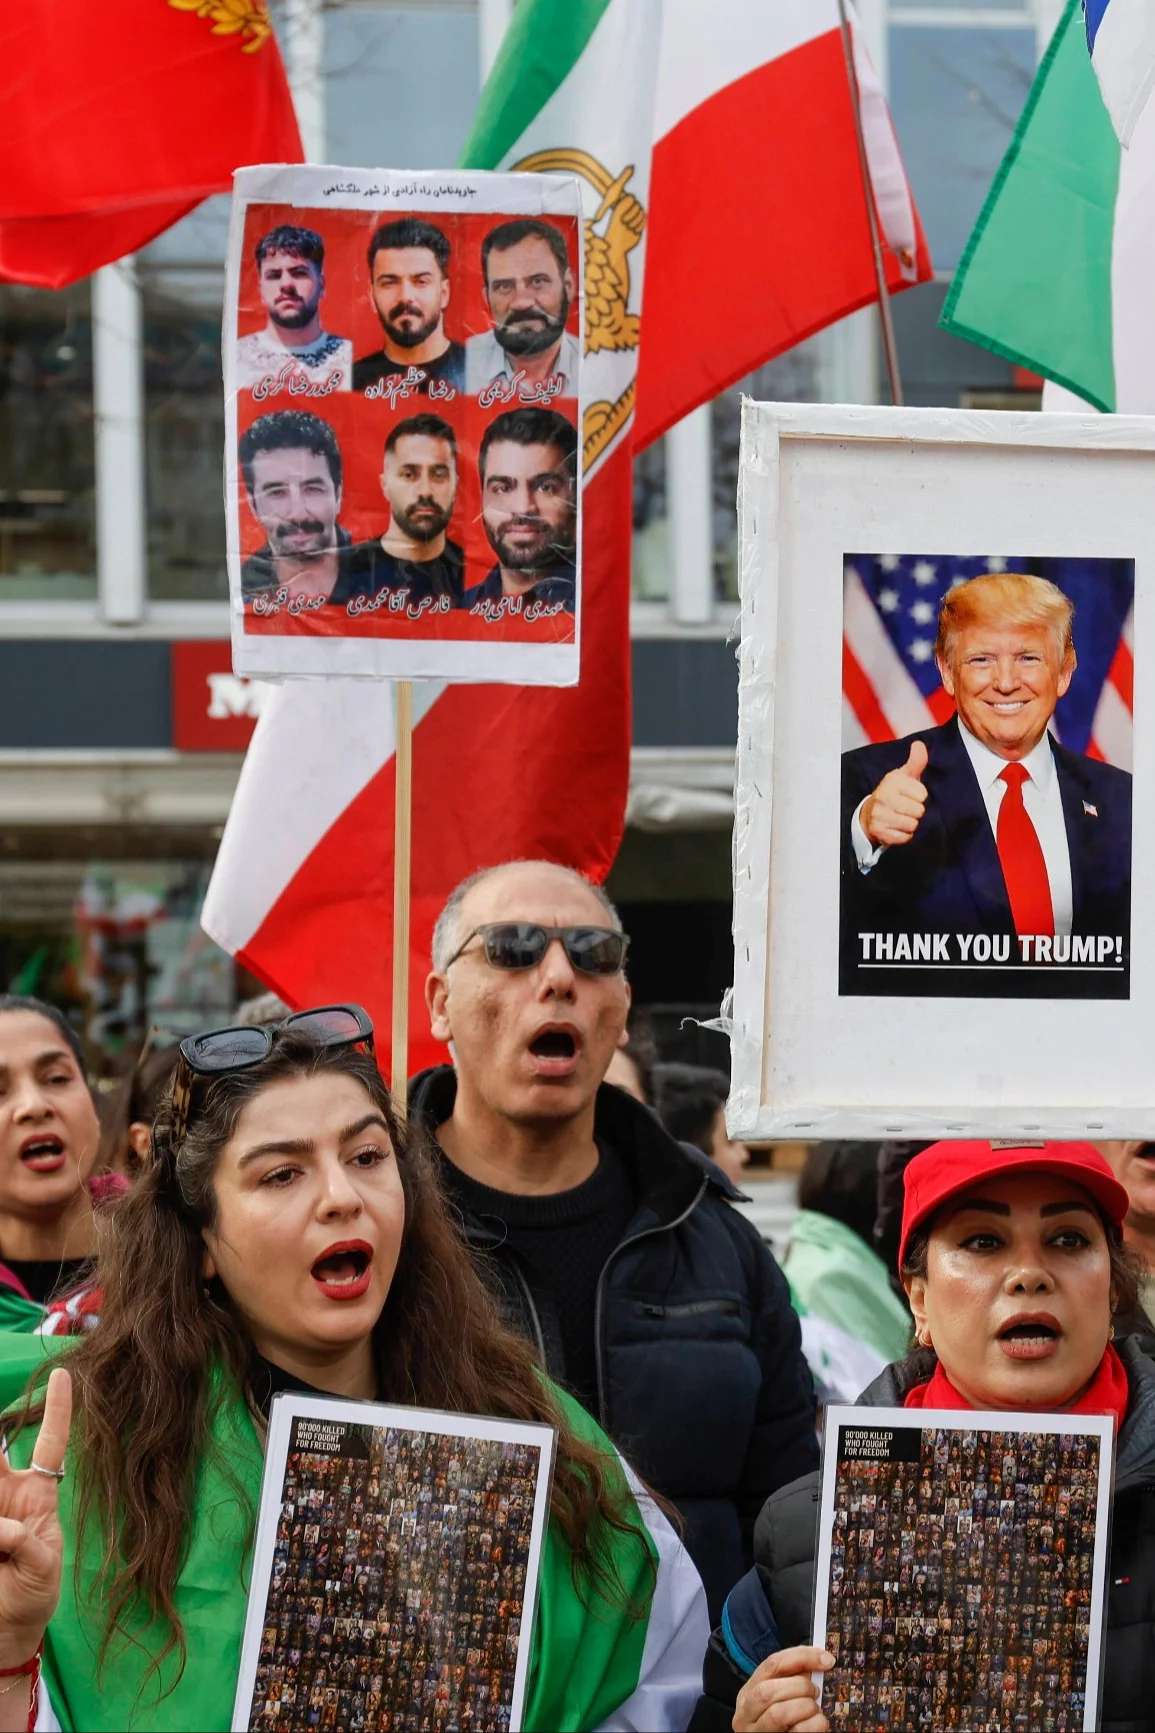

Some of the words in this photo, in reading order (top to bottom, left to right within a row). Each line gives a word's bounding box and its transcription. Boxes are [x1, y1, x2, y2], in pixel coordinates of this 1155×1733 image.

[392, 182, 416, 197] آزادی
[429, 380, 456, 401] رضا
[479, 370, 526, 408] کریمی
[519, 376, 563, 404] لطیف
[287, 594, 326, 616] مهدی
[858, 932, 950, 961] THANK
[956, 933, 1010, 961] YOU
[1018, 935, 1123, 963] TRUMP!
[297, 1430, 313, 1440] WHO
[313, 1433, 340, 1443] FOUGHT
[321, 1425, 345, 1435] KILLED
[845, 1430, 869, 1440] 90'000
[869, 1431, 893, 1441] KILLED
[295, 1440, 309, 1448] FOR
[310, 1441, 341, 1452] FREEDOM
[845, 1439, 860, 1448] WHO
[862, 1440, 888, 1449] FOUGHT
[844, 1447, 858, 1456] FOR
[859, 1448, 890, 1457] FREEDOM
